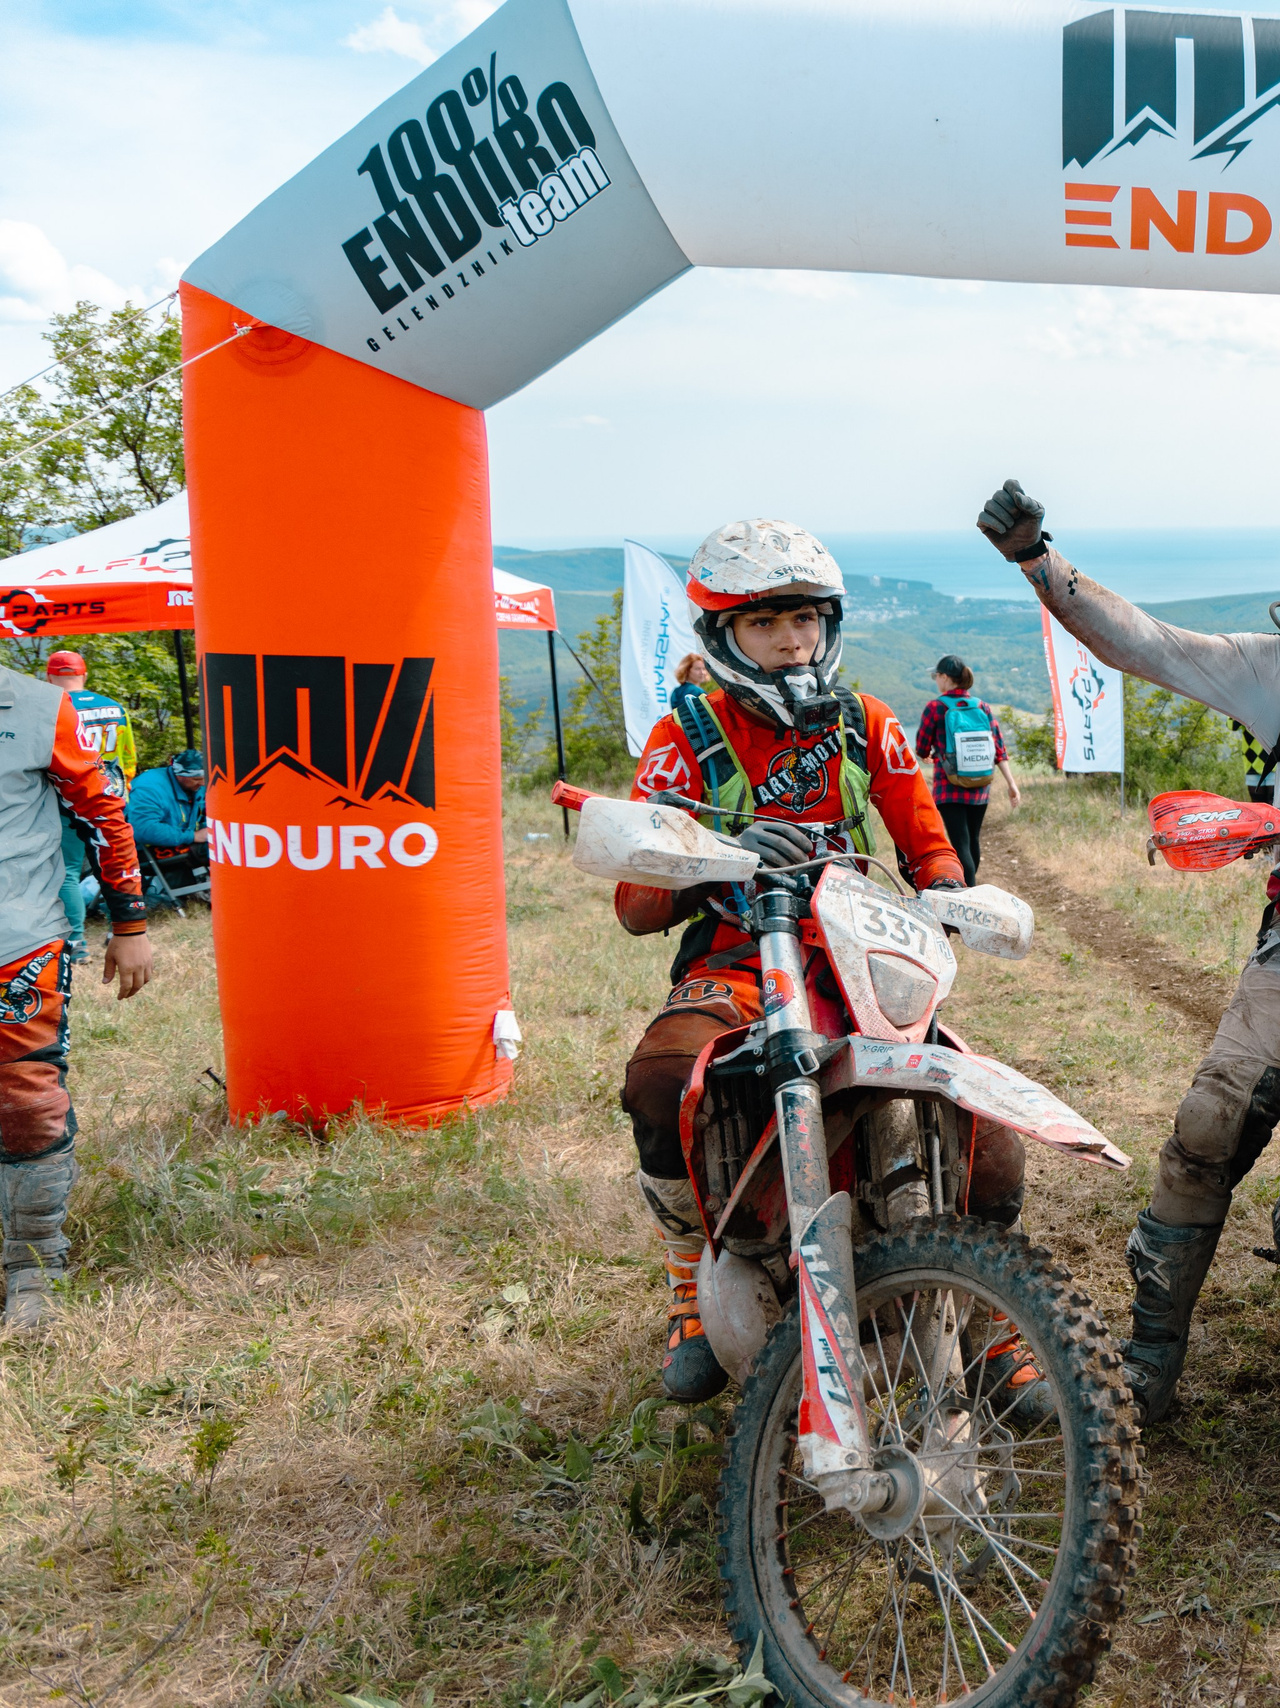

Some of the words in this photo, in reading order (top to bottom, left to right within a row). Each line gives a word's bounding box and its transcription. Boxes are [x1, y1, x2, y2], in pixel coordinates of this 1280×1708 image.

[357, 51, 529, 212] 100%
[341, 82, 597, 315] ENDURO
[497, 146, 612, 248] team
[366, 239, 514, 353] GELENDZHIK
[774, 565, 817, 578] SHOEI
[12, 601, 106, 618] PARTS
[963, 754, 990, 763] MEDIA
[860, 901, 929, 957] 337
[860, 1043, 895, 1054] X-GRIP
[817, 1337, 837, 1367] PRO
